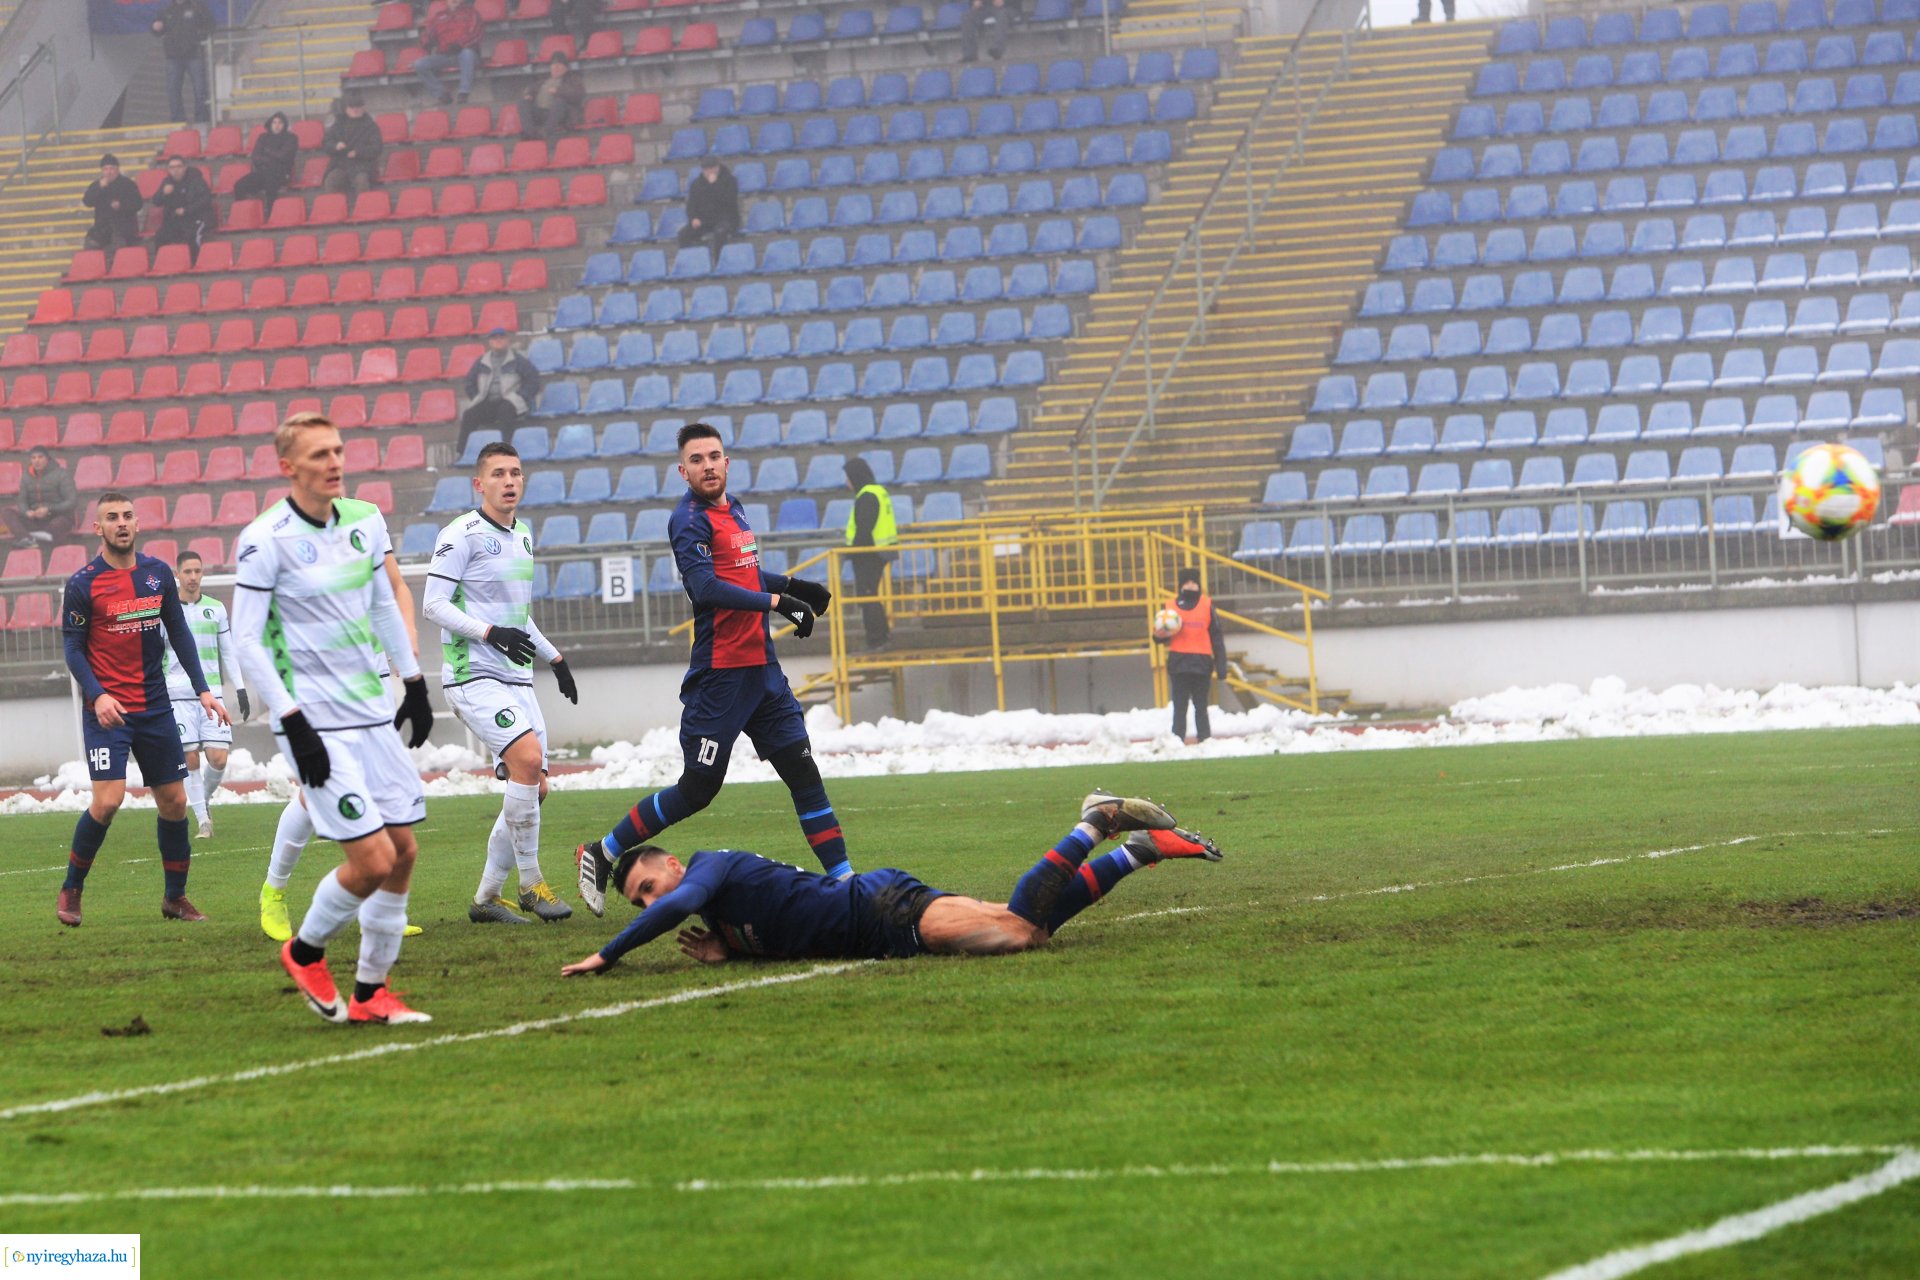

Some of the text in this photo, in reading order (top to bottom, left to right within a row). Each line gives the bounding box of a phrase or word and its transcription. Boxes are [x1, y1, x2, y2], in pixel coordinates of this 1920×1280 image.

[611, 576, 625, 597] B
[89, 747, 111, 771] 48
[697, 737, 719, 766] 10
